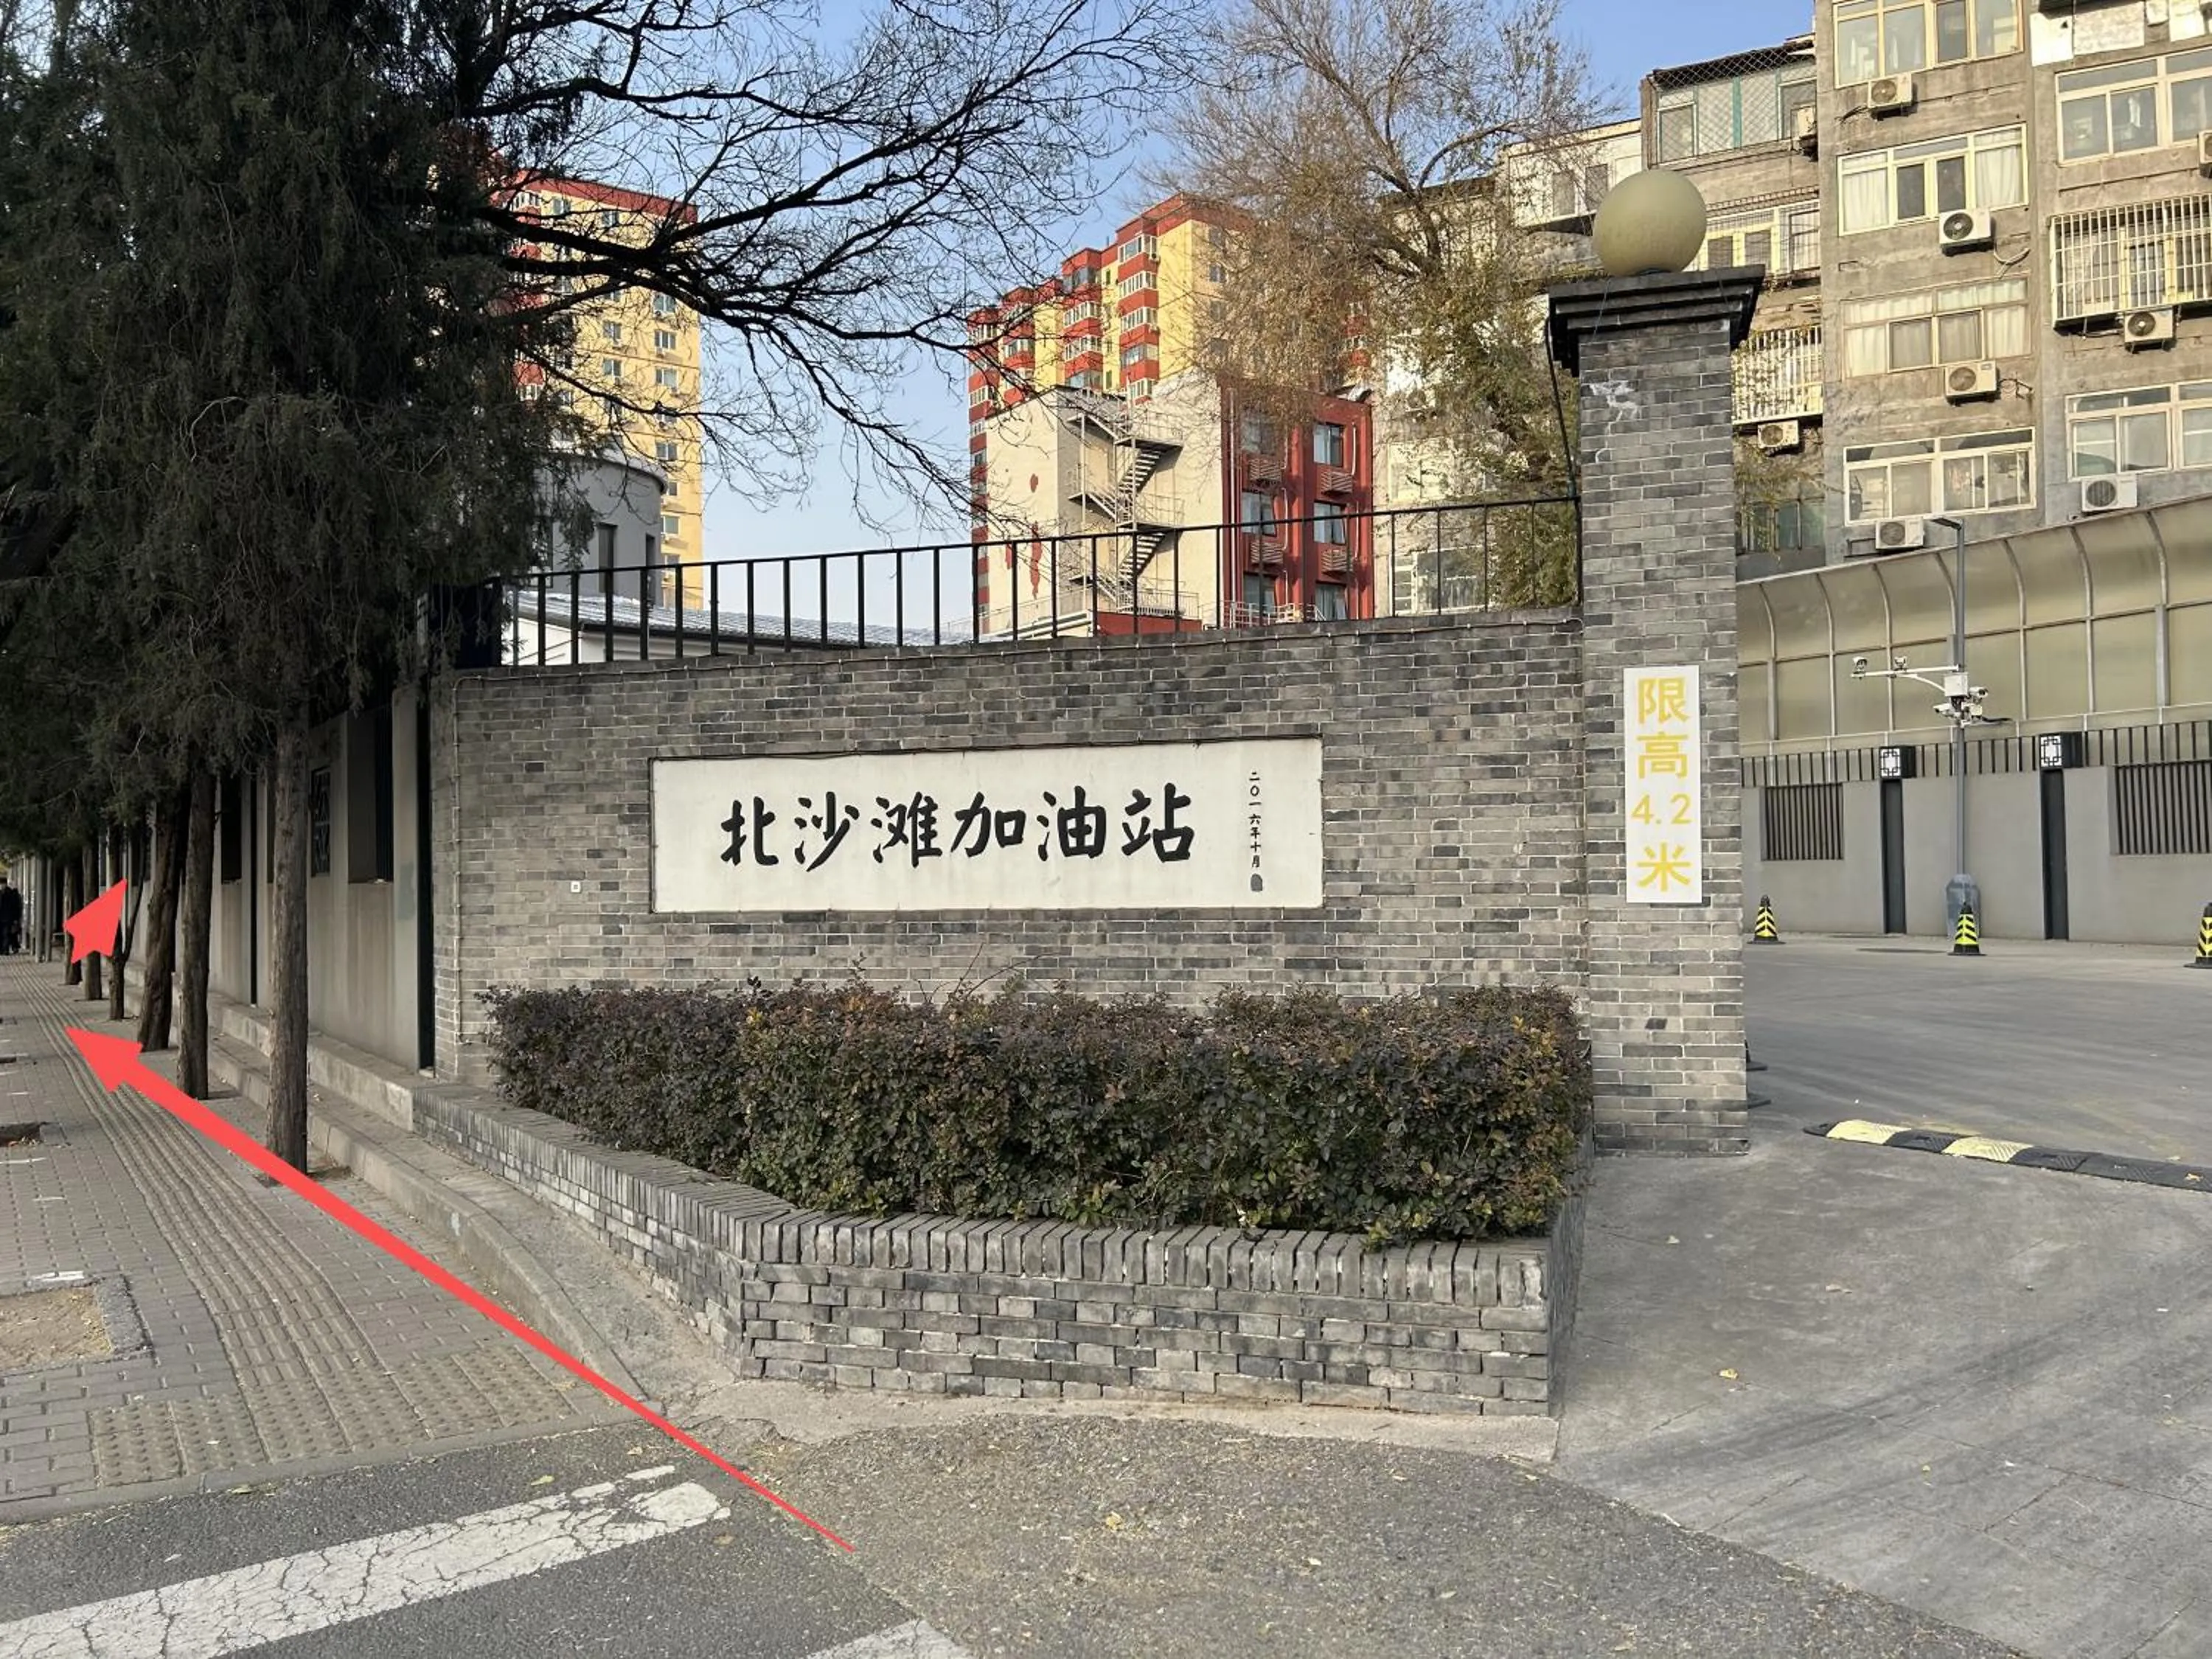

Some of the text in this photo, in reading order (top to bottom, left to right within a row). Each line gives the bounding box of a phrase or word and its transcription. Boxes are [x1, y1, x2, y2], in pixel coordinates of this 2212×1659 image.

[720, 782, 1195, 872] 北沙滩加油站
[1631, 676, 1692, 892] 限高4.2米
